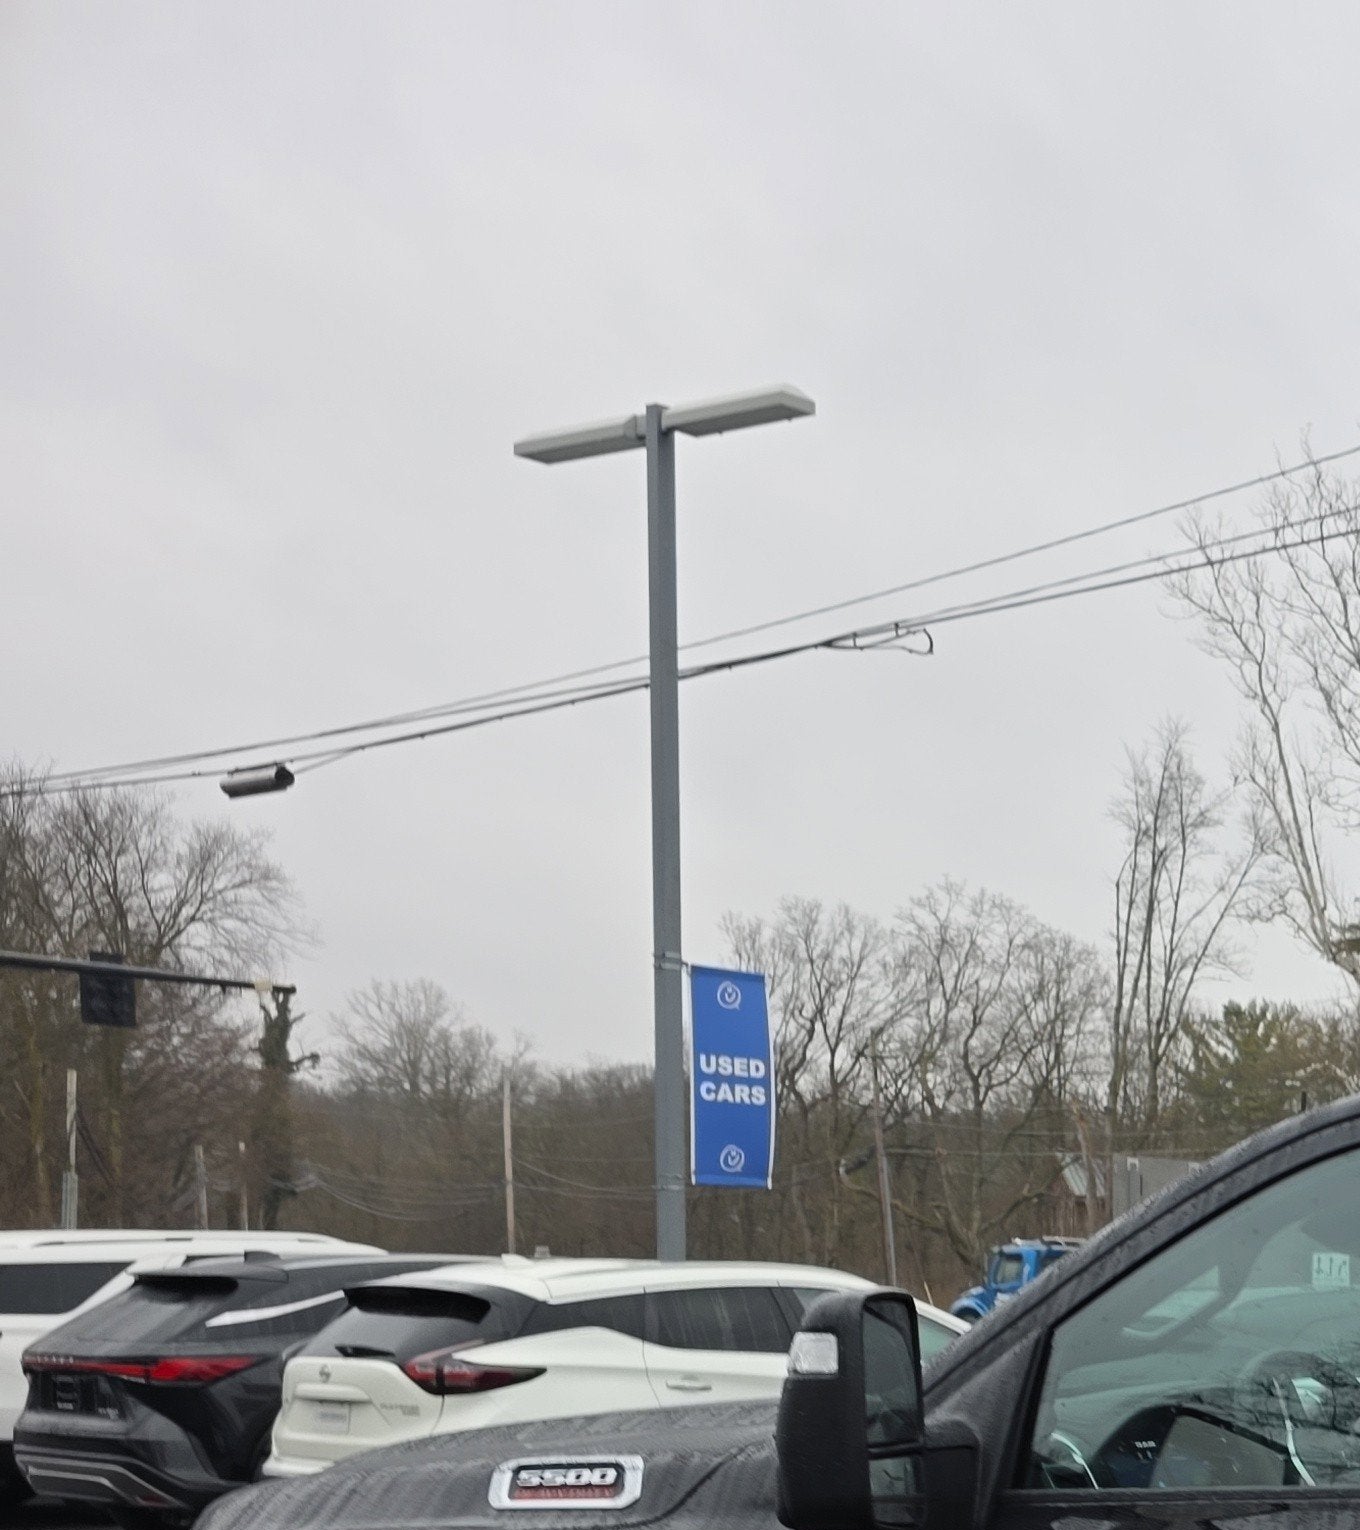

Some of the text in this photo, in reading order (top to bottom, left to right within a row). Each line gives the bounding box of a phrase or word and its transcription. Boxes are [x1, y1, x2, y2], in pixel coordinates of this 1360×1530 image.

[700, 1053, 766, 1079] USED
[700, 1080, 766, 1106] CARS
[516, 1467, 618, 1487] 5500
